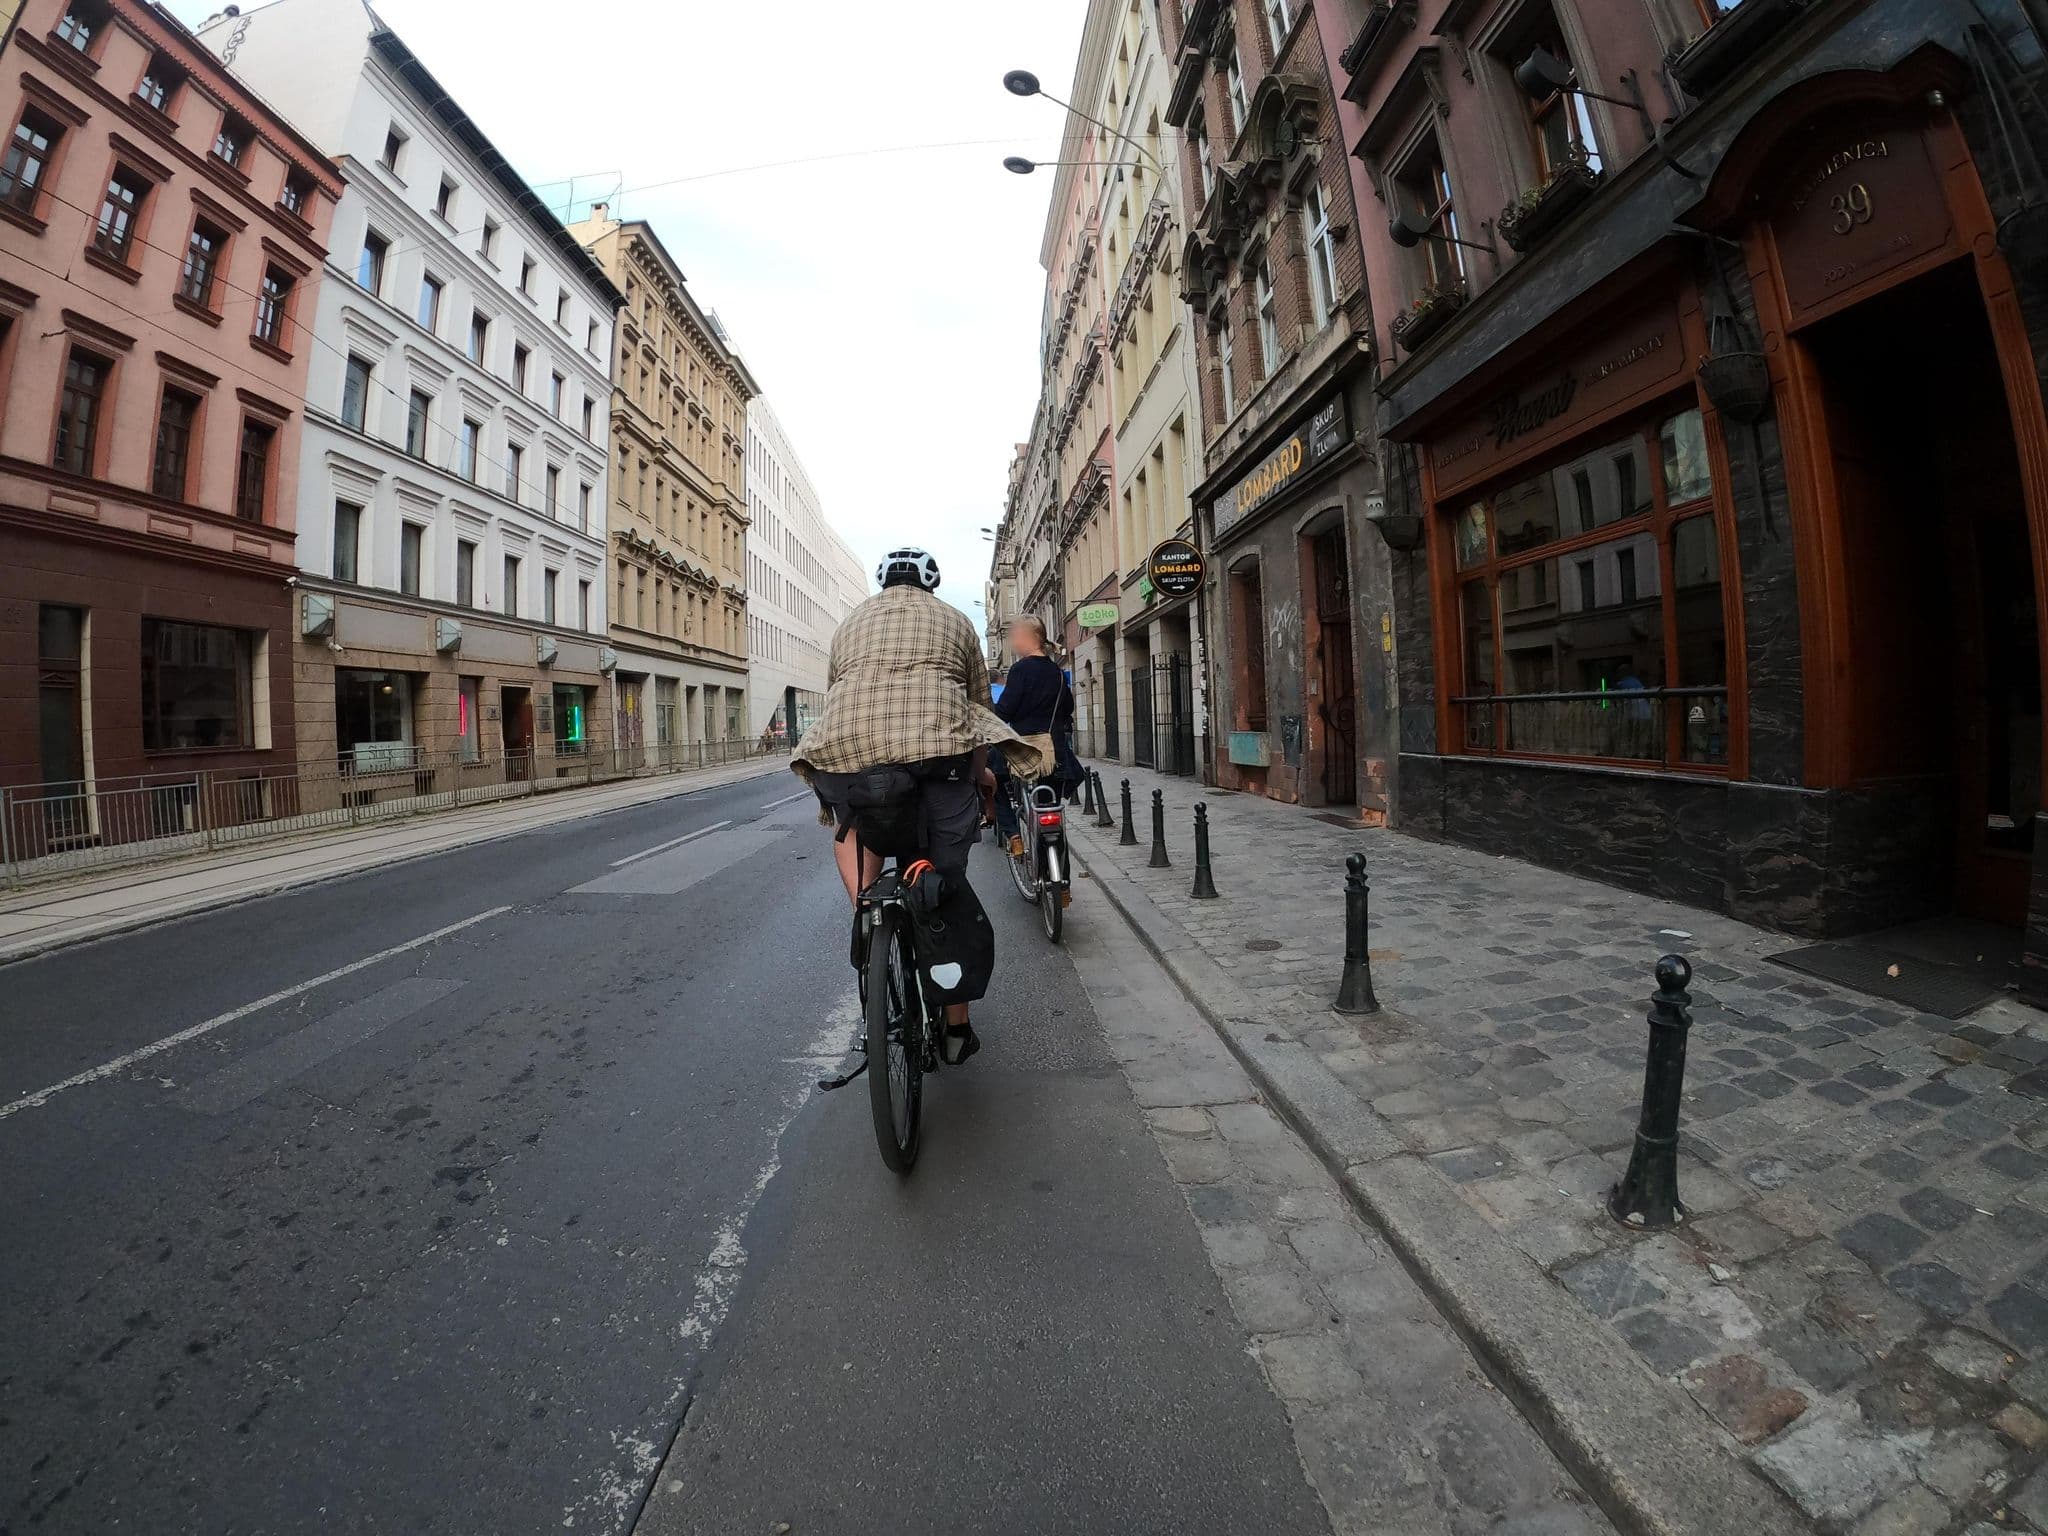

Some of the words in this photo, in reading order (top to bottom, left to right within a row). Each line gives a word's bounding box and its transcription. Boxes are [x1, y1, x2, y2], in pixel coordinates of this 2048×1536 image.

[1792, 140, 1888, 212] KMIENICA
[1830, 183, 1872, 235] 39
[1314, 404, 1334, 431] SKUP
[1236, 437, 1303, 513] LOMBARD
[1154, 563, 1201, 573] LOMBARD
[1161, 553, 1191, 561] KANTOR
